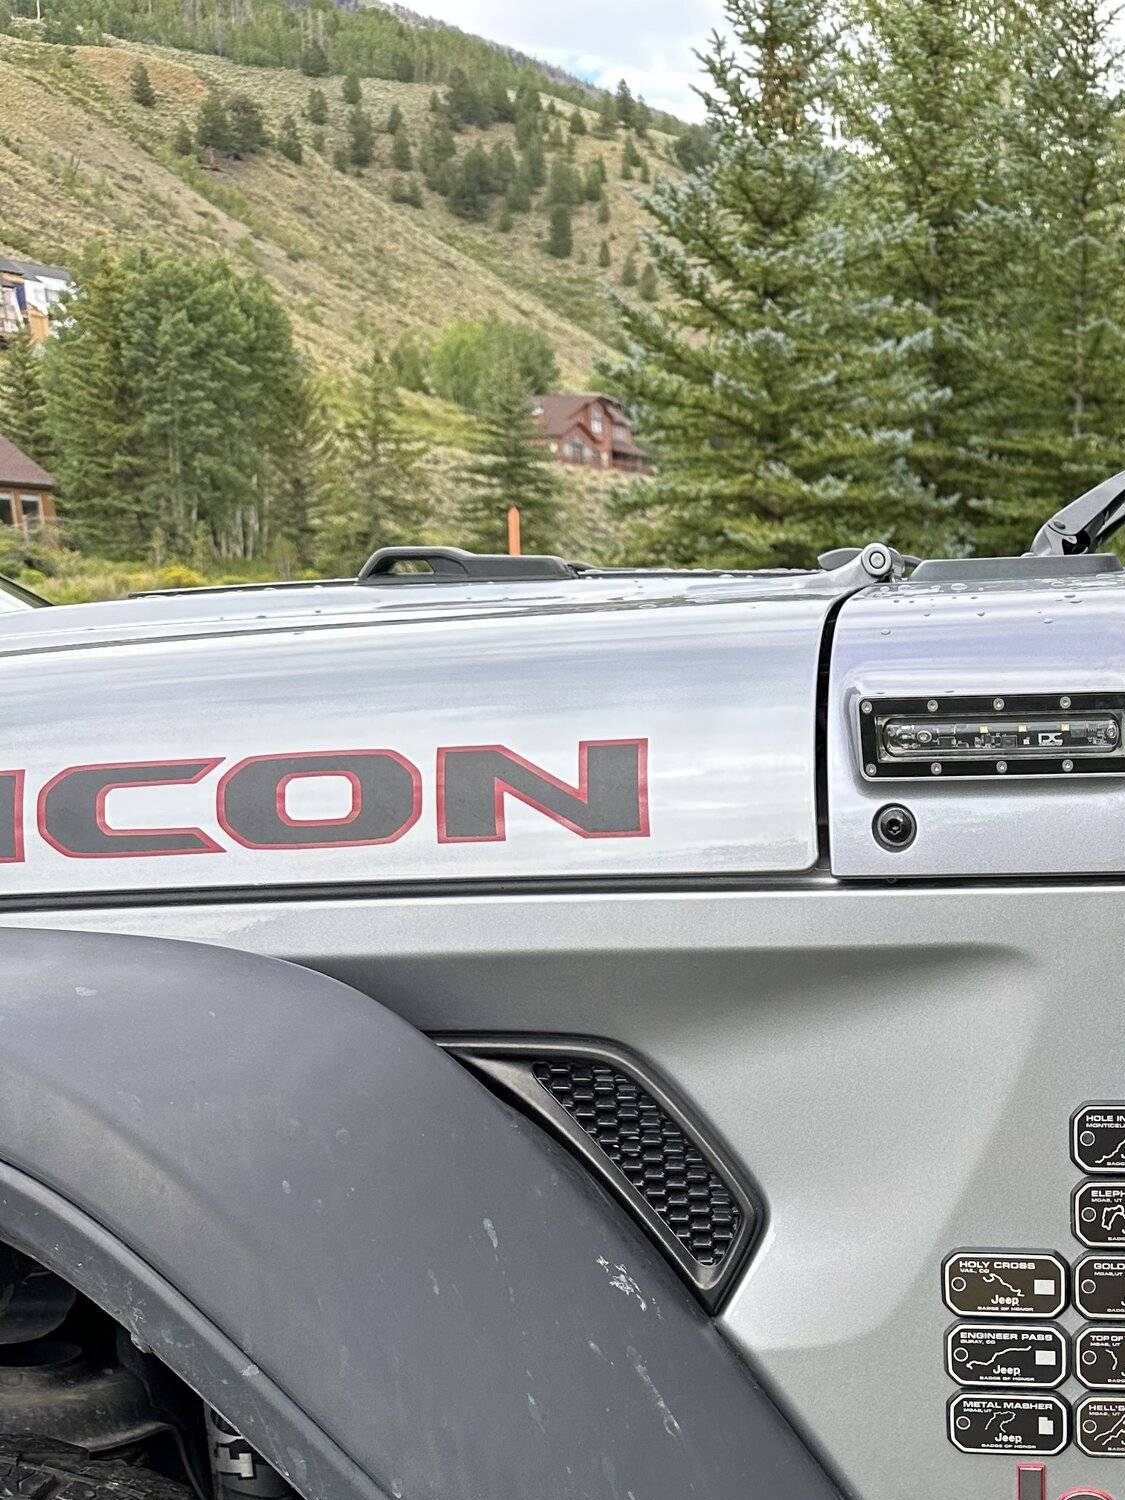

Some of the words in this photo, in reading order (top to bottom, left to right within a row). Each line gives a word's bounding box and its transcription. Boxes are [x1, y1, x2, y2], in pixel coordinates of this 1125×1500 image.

[1086, 1114, 1113, 1122] HOLE
[959, 1261, 990, 1269] HOLY
[994, 1261, 1036, 1270] CROSS
[991, 1295, 1019, 1305] Jeep
[960, 1332, 1018, 1340] ENGINEER
[1021, 1333, 1053, 1341] PASS
[993, 1365, 1021, 1375] Jeep
[963, 1400, 1001, 1408] METAL
[1003, 1401, 1053, 1410] MASHER
[995, 1433, 1022, 1443] Jeep
